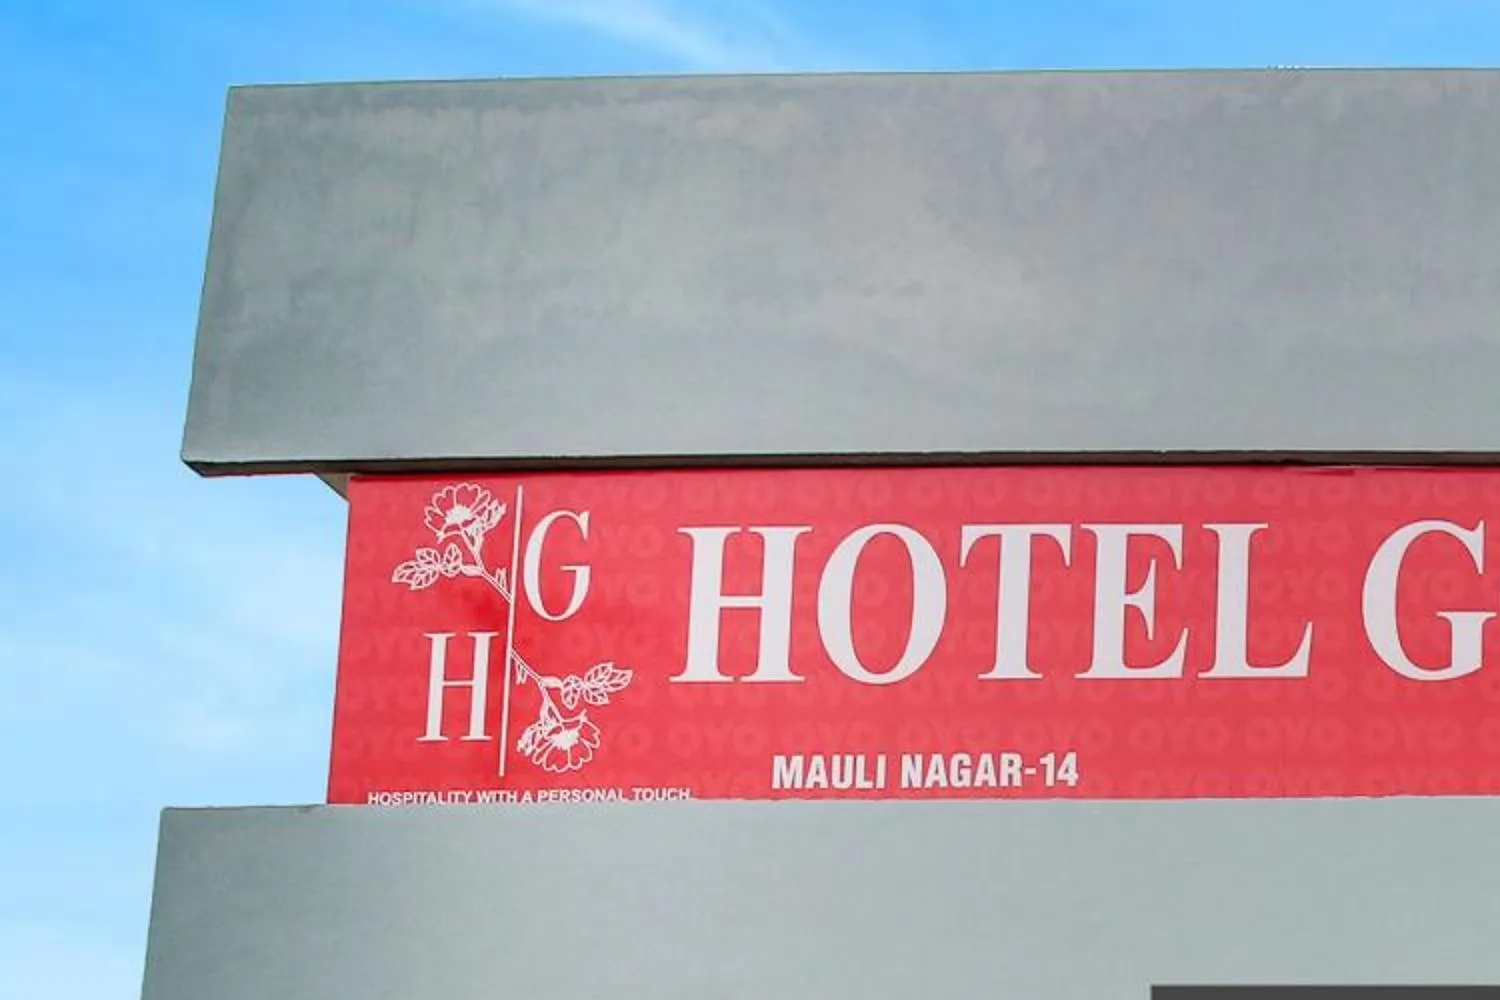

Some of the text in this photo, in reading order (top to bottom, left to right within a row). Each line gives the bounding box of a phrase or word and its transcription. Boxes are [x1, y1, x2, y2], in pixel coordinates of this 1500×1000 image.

[522, 510, 592, 621] G
[669, 522, 1313, 685] HOTEL
[416, 632, 501, 742] H
[367, 787, 692, 806] HOSPITALITY WITH A PERSONAL TOUCH
[771, 755, 886, 789] MAULI
[901, 752, 1079, 788] NAGAR-14
